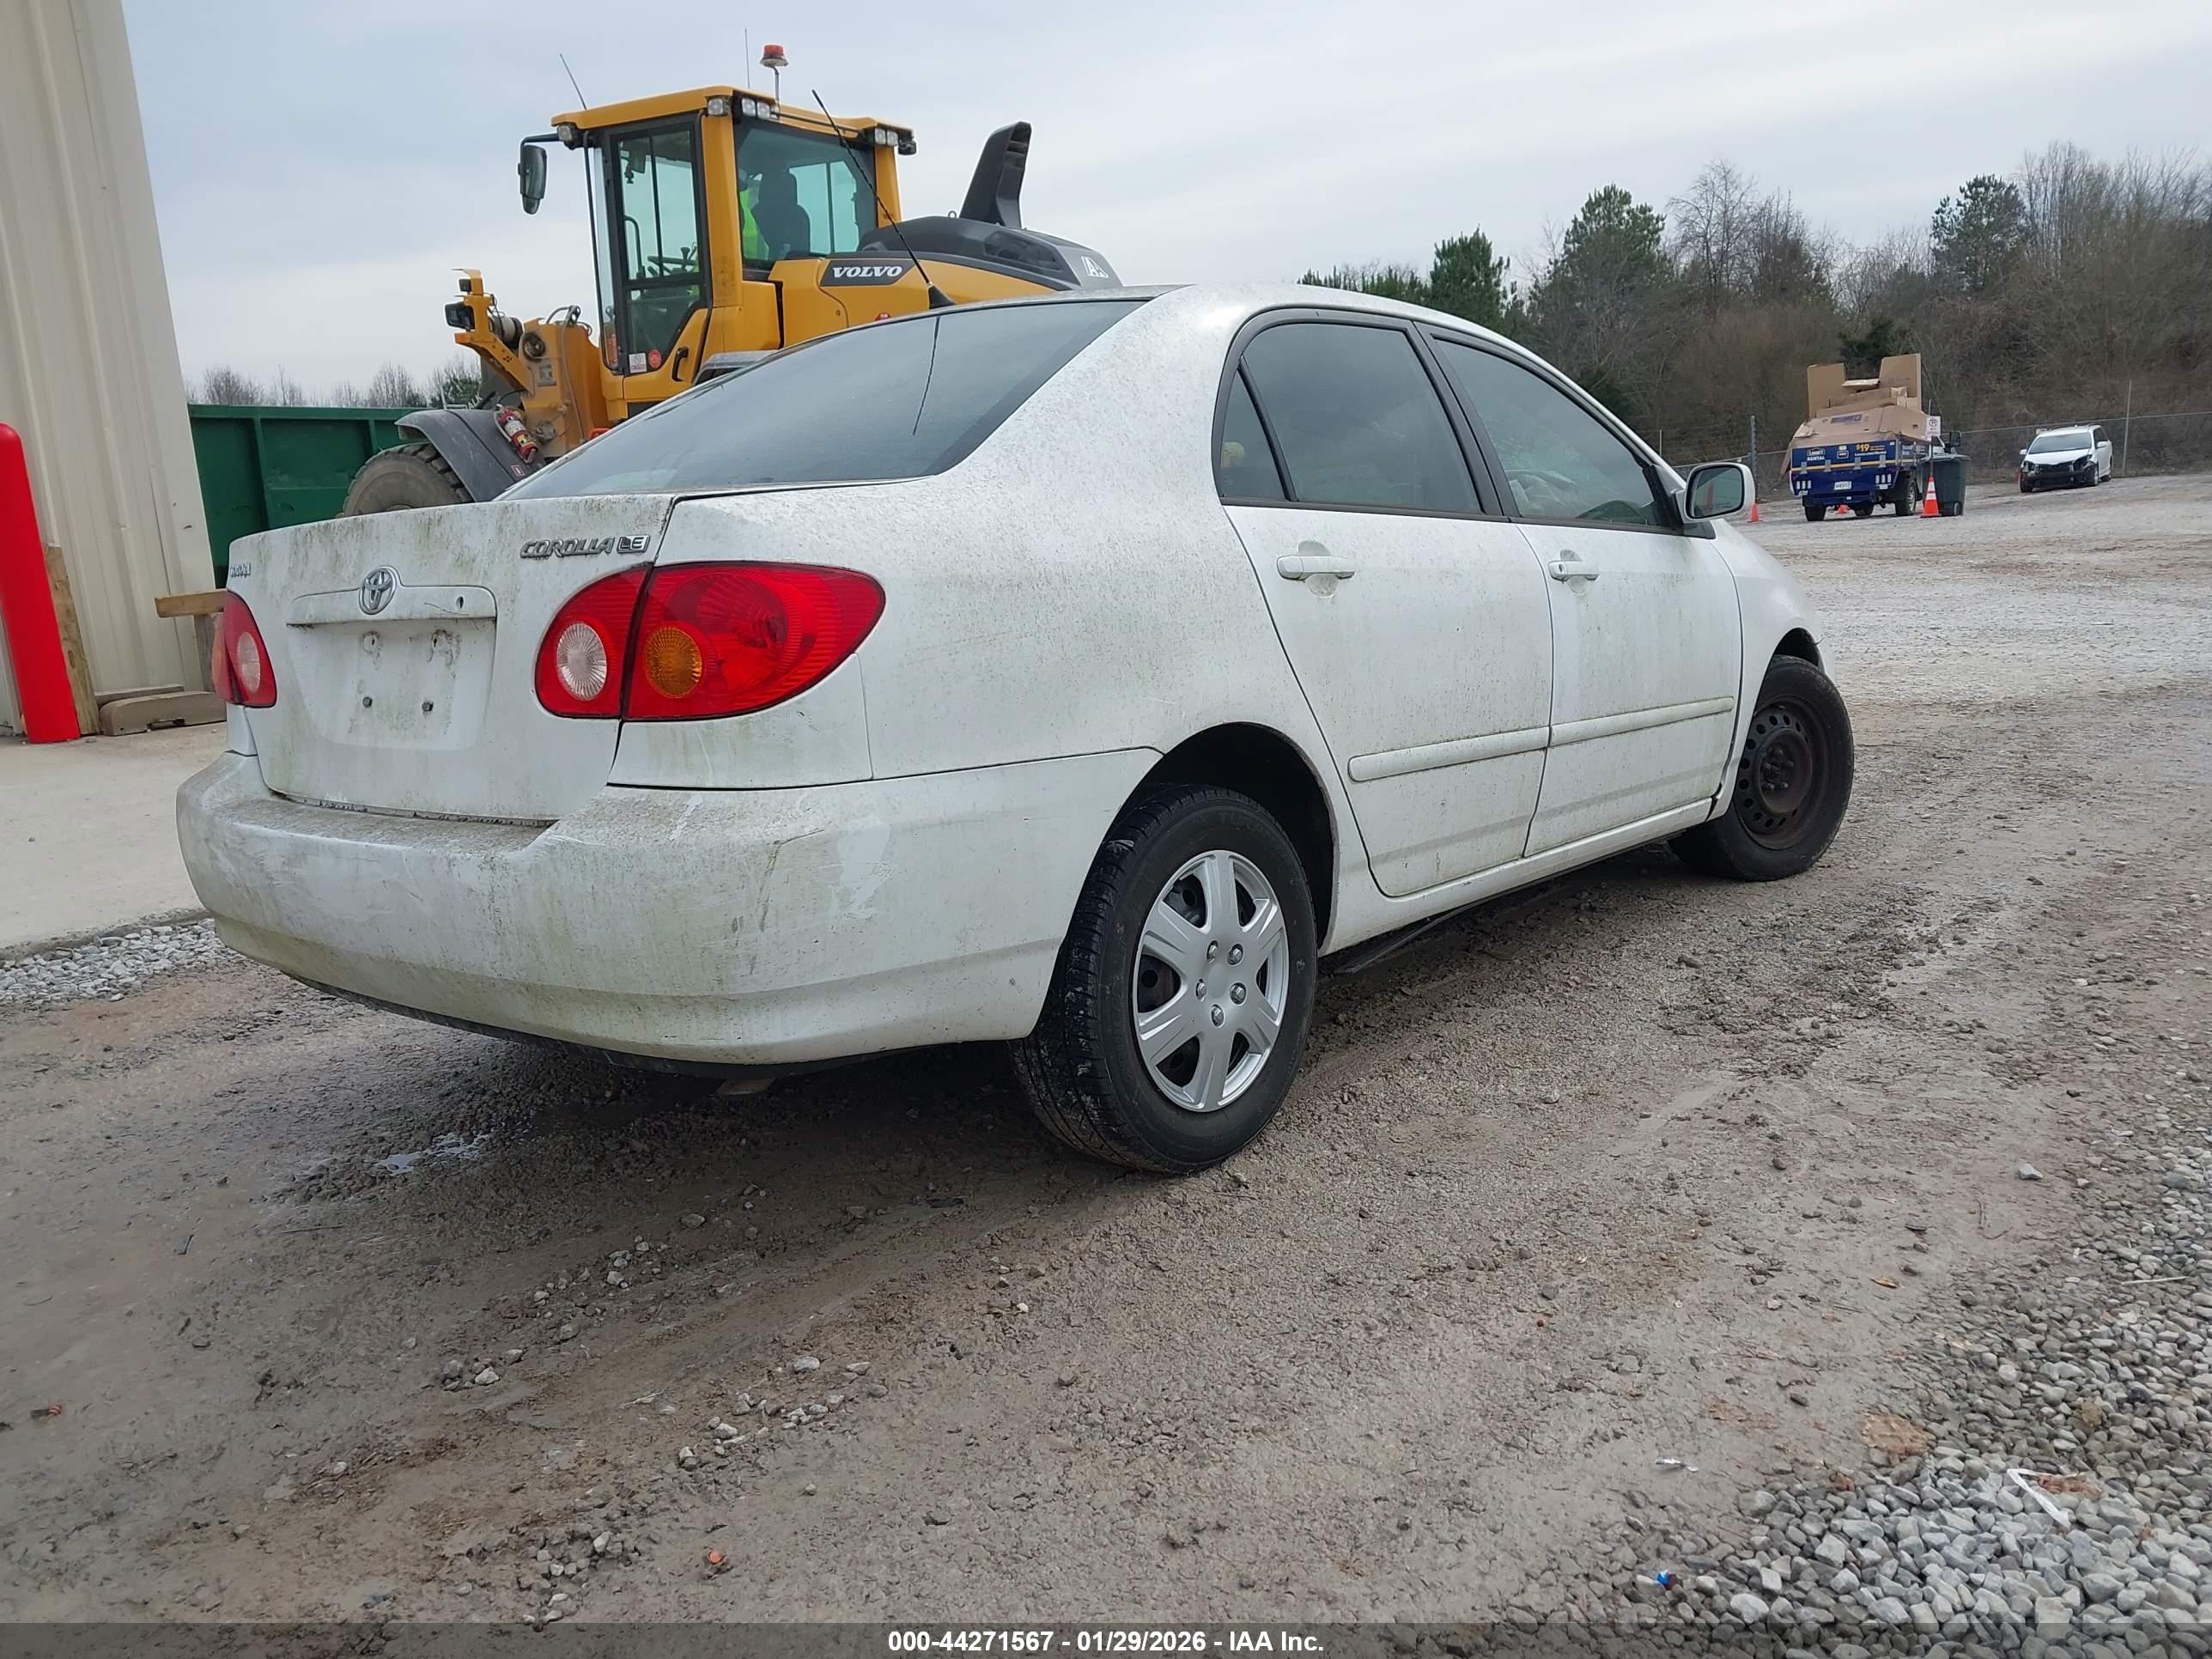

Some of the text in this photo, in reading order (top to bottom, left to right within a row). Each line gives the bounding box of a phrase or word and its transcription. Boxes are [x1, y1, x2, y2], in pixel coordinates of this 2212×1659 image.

[833, 266, 902, 277] VOLVO
[520, 535, 650, 558] COROLLA LE
